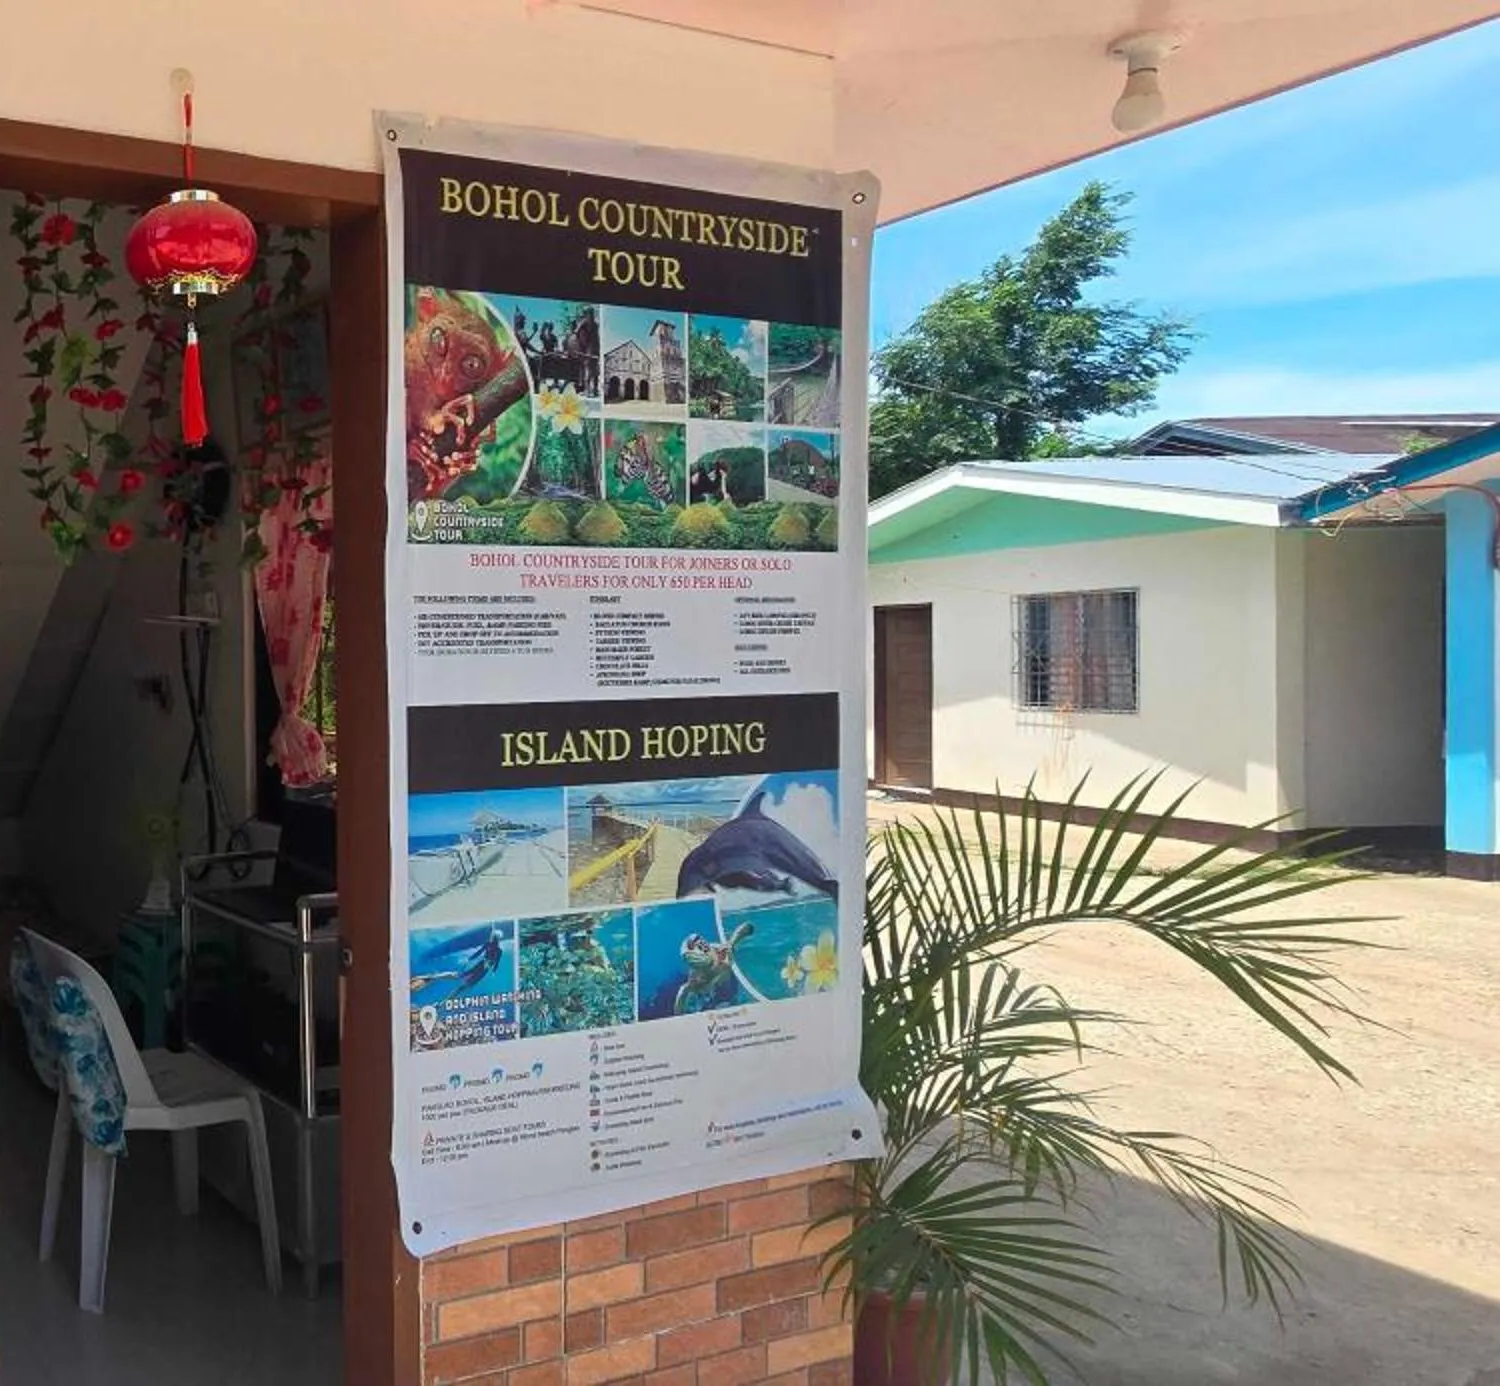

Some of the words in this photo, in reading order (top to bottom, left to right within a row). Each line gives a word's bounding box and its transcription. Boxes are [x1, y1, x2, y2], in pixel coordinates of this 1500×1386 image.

[440, 177, 570, 227] BOHOL
[579, 197, 809, 258] COUNTRYSIDE
[588, 248, 685, 290] TOUR
[433, 529, 463, 541] TOUR
[470, 553, 518, 567] BOHOL
[523, 554, 620, 569] COUNTRYSIDE
[623, 555, 661, 569] TOUR
[662, 556, 685, 569] FOR
[689, 557, 739, 570] JOINERS
[520, 573, 599, 588] TRAVELERS
[603, 574, 627, 588] FOR
[632, 575, 668, 590] ONLY
[692, 576, 714, 588] PER
[719, 576, 753, 589] HEAD
[501, 728, 632, 768] ISLAND
[640, 721, 766, 760] HOPING
